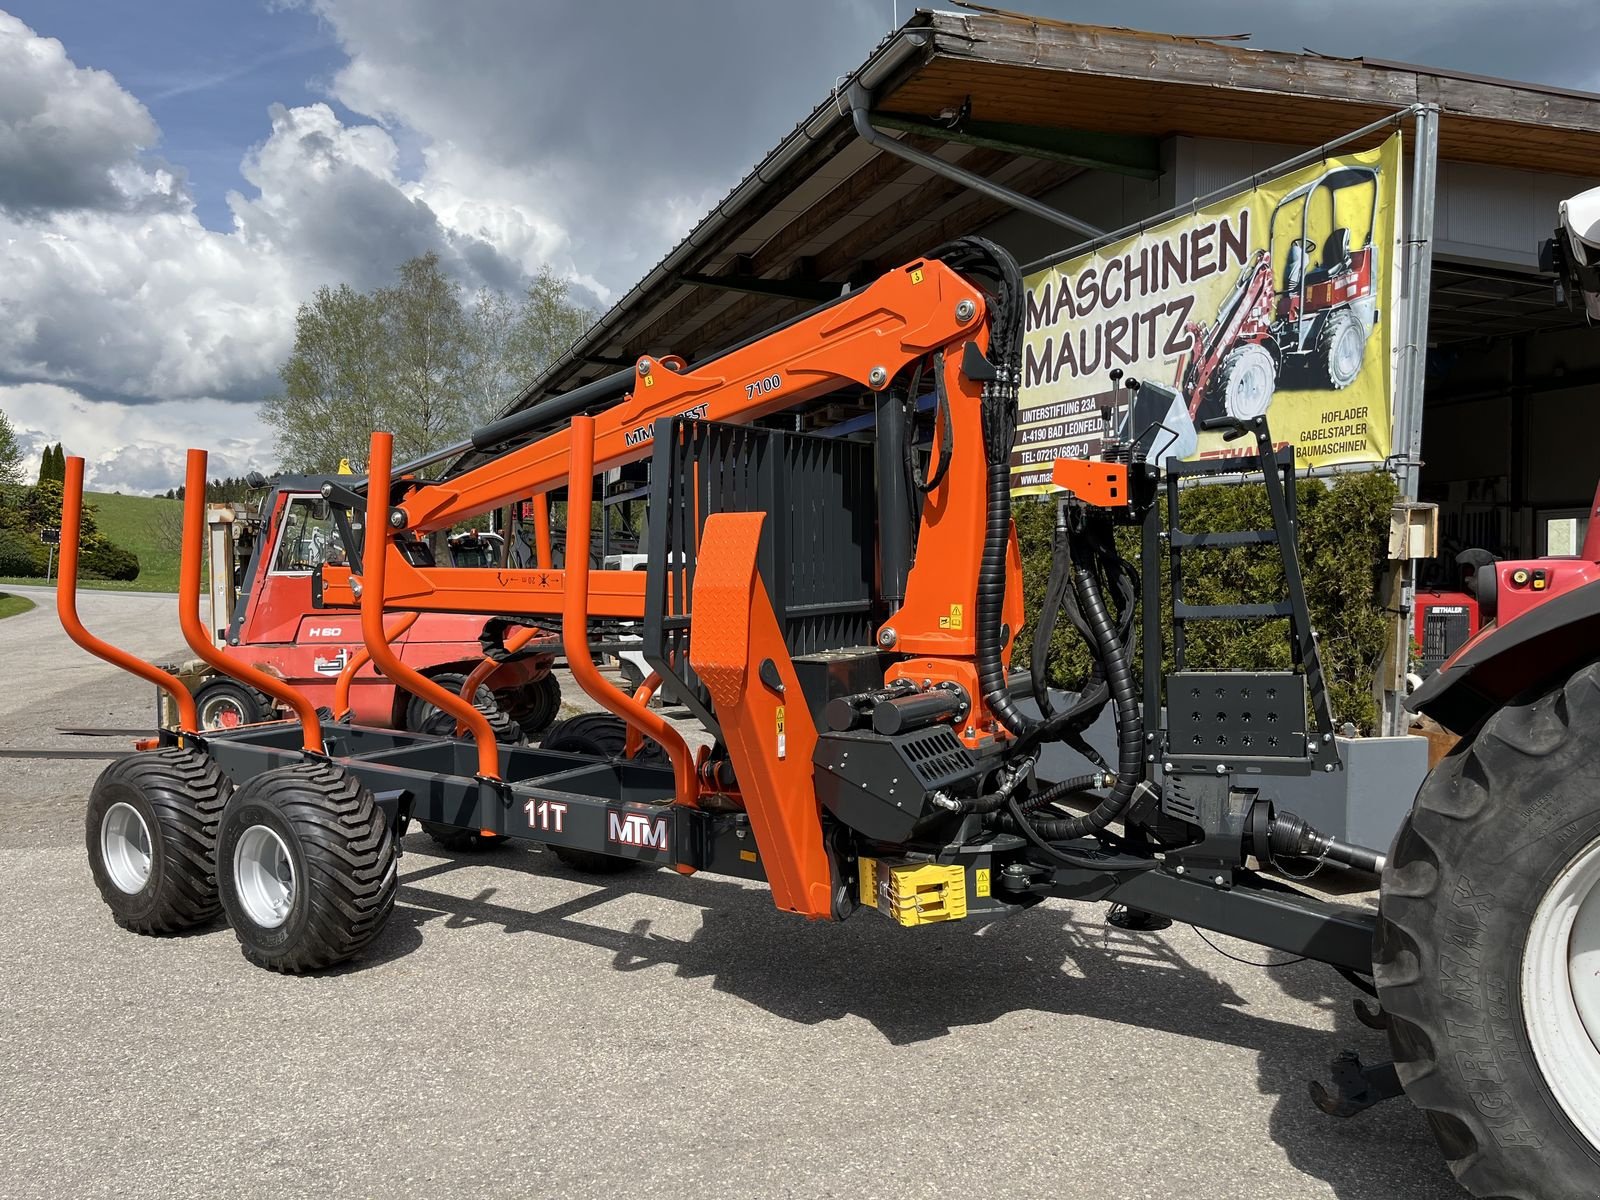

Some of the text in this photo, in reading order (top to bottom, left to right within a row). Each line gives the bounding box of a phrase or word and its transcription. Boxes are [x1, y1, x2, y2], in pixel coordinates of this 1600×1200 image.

[1025, 210, 1249, 333] MASCHINEN
[1025, 295, 1195, 389] MAURITZ
[745, 374, 781, 399] 7100
[1022, 397, 1096, 423] UNTERSTIFTUNG 23A
[1322, 406, 1368, 424] HOFLADER
[624, 423, 655, 447] MTM
[1021, 430, 1046, 443] A-4190
[1047, 424, 1063, 439] BAD
[1300, 423, 1367, 442] GABELSTAPLER
[1021, 452, 1036, 464] TEL:
[1296, 440, 1367, 458] BAUMASCHINEN
[1020, 472, 1053, 485] www.mas
[1439, 606, 1463, 614] THALER
[524, 799, 668, 851] 11T MTM
